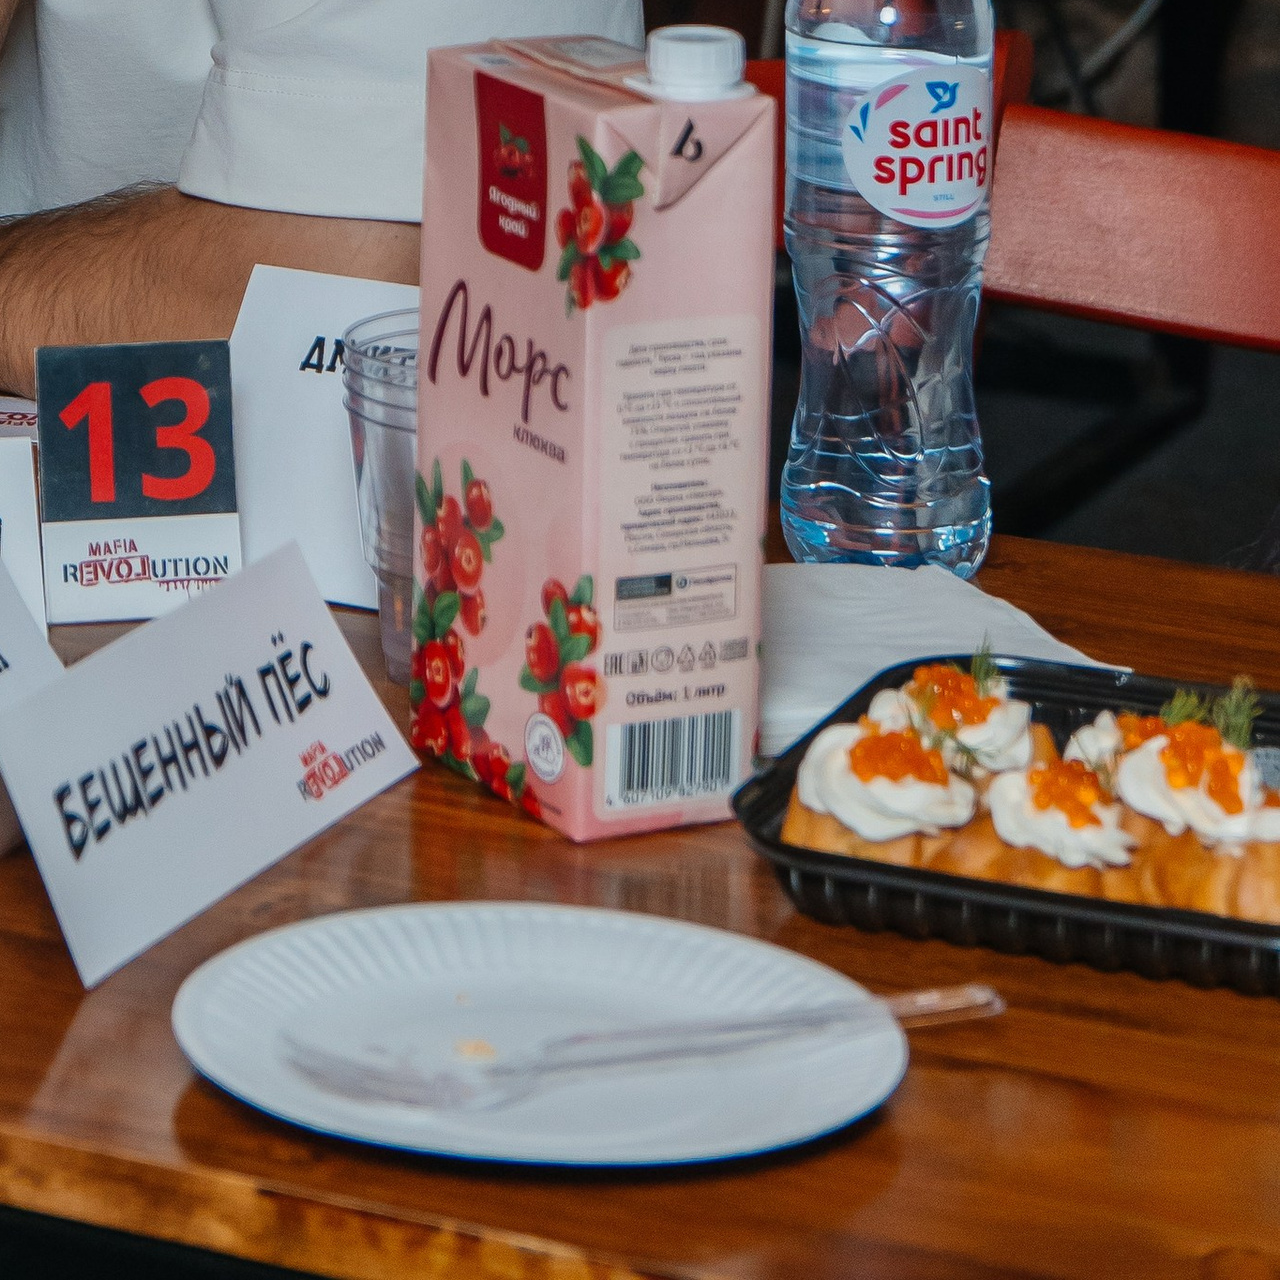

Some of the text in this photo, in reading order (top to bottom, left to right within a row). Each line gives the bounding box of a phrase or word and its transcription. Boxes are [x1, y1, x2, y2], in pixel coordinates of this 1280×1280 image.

[888, 106, 982, 149] saint
[872, 144, 987, 196] spring
[58, 376, 217, 504] 13
[87, 538, 139, 558] MAFIA
[256, 630, 331, 726] ПЁС
